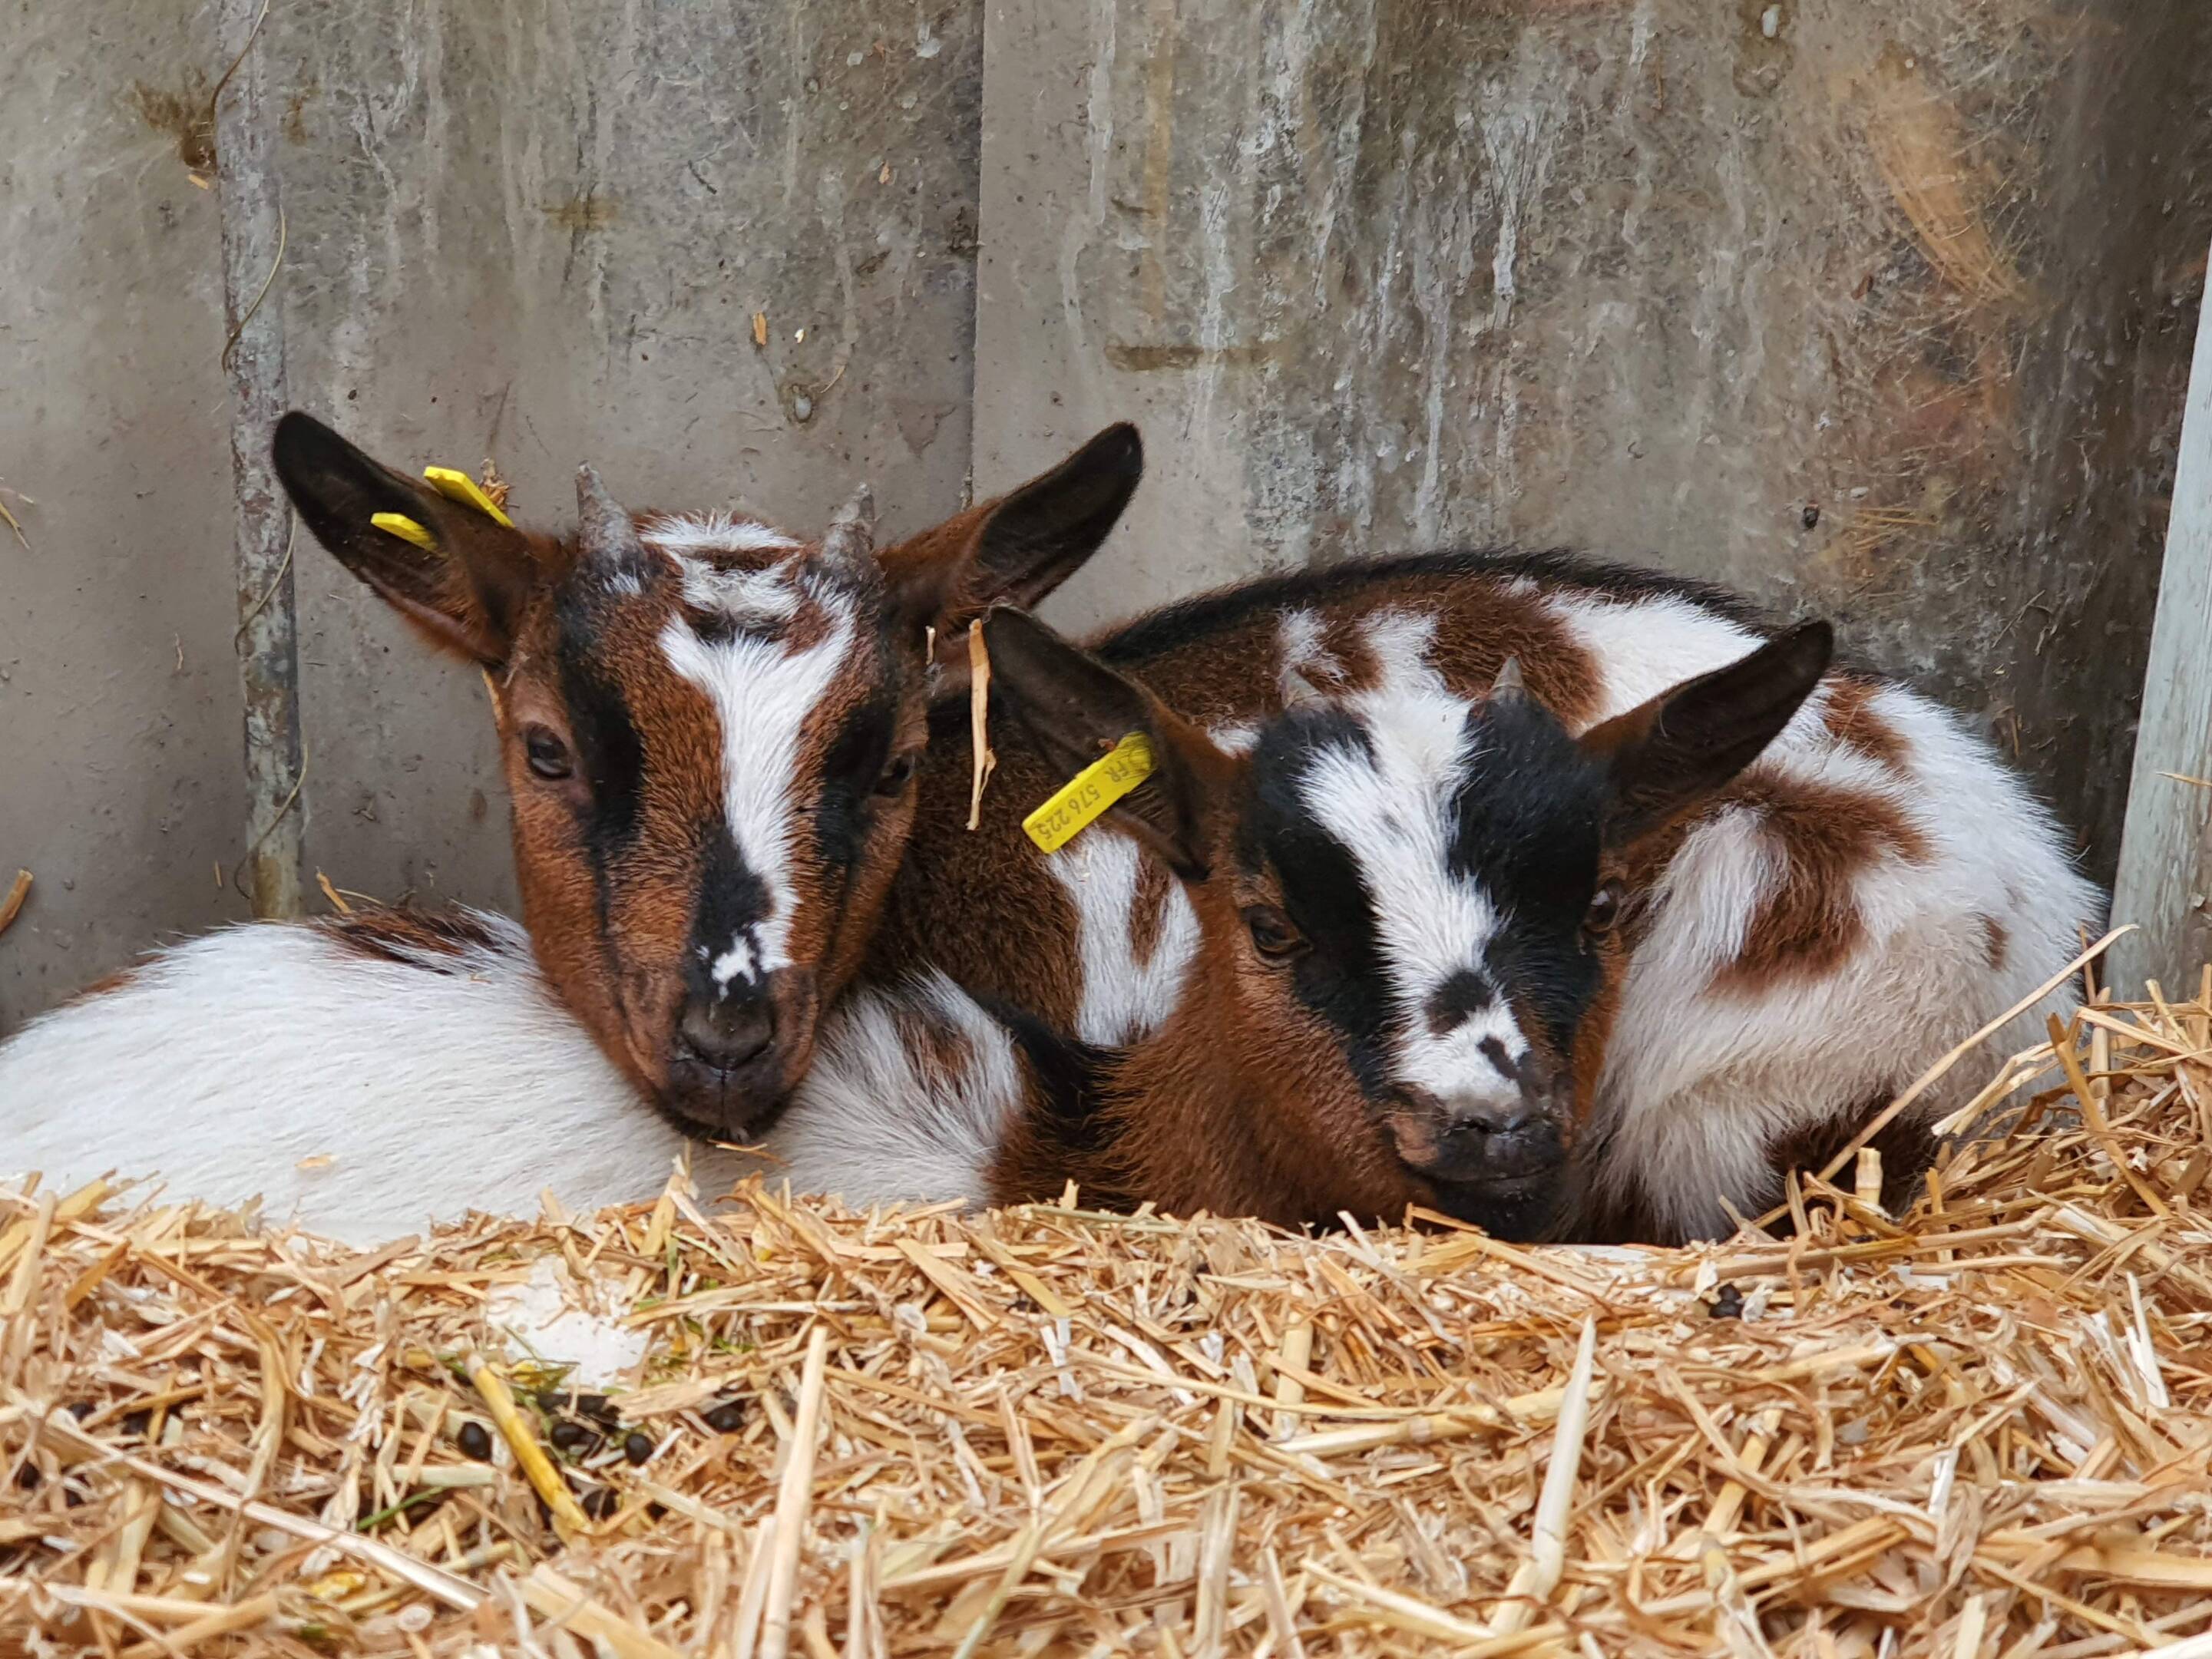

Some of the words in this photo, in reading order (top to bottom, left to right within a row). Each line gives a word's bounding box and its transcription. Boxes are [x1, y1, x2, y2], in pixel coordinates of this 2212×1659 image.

[1106, 761, 1130, 782] FR
[1068, 784, 1101, 815] 576
[1037, 808, 1071, 840] 225
